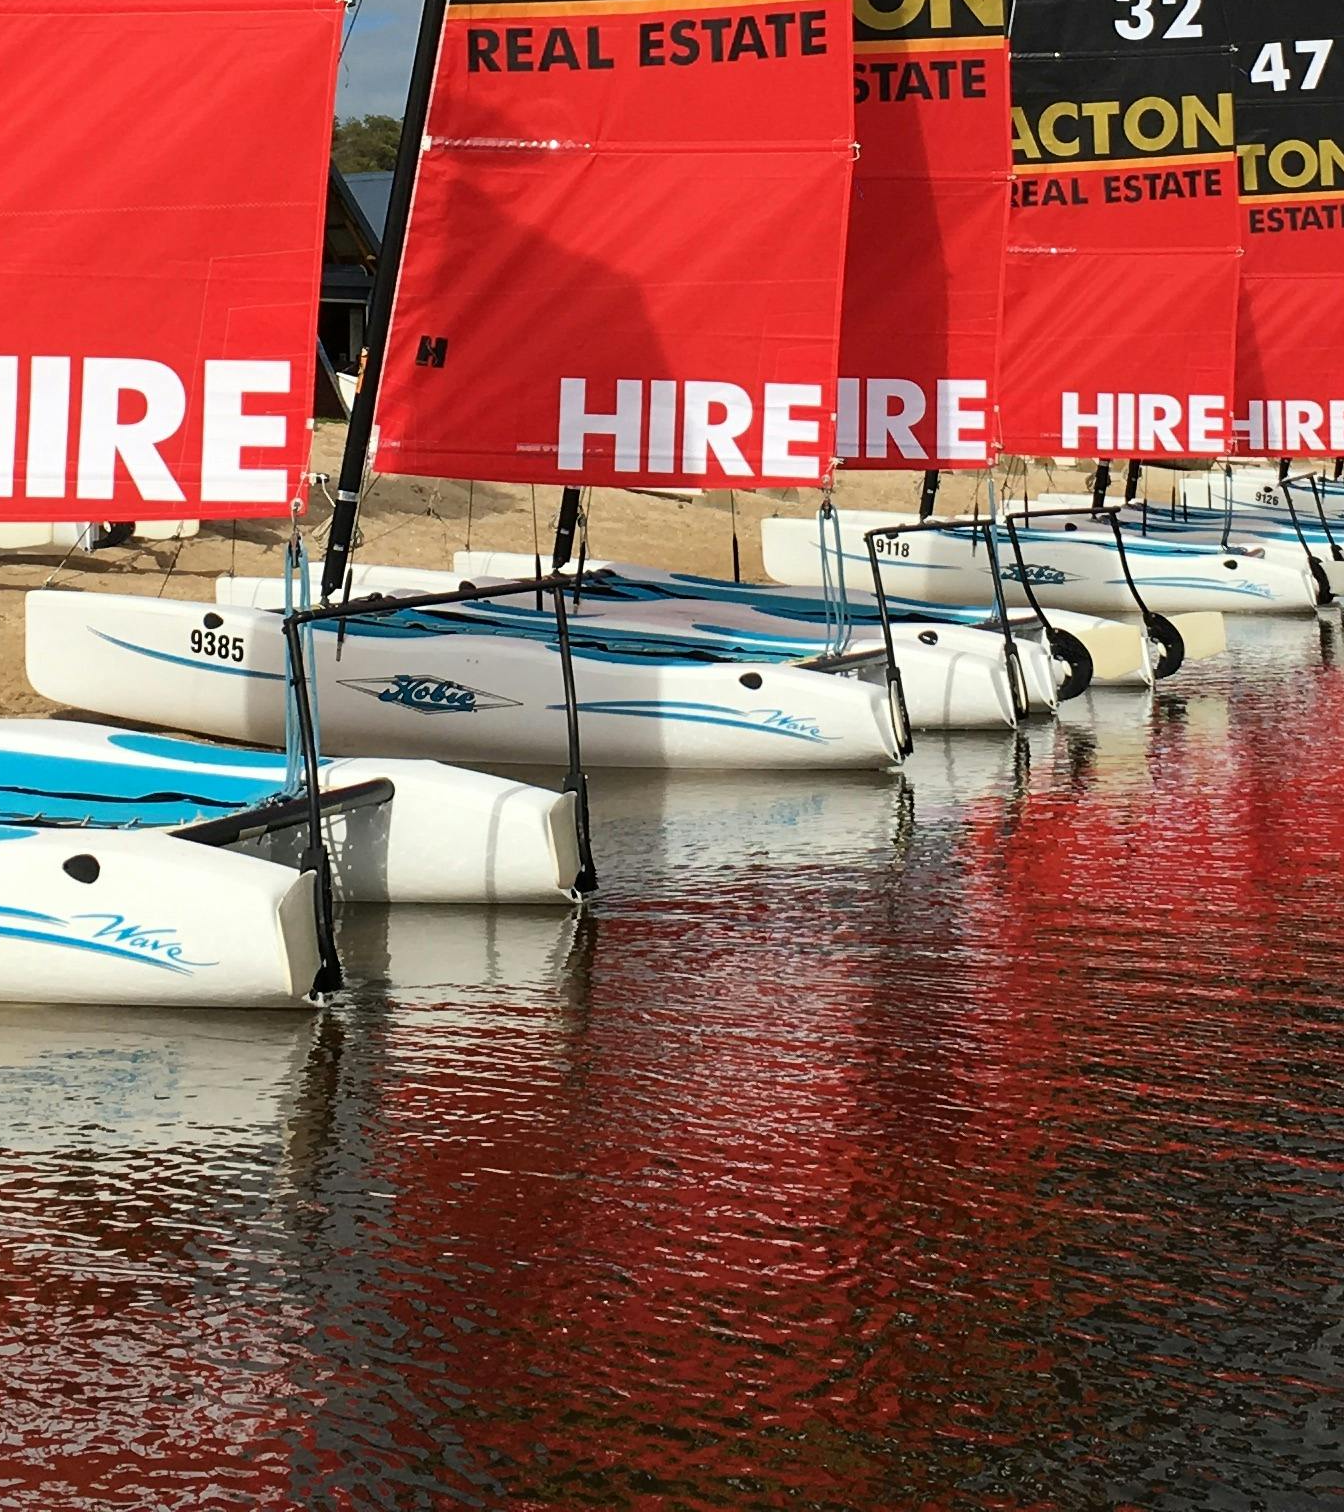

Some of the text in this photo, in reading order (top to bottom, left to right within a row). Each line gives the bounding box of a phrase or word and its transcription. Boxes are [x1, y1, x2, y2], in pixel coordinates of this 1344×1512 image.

[467, 10, 828, 72] REAL ESTATE
[1250, 39, 1333, 92] 47
[1011, 93, 1234, 159] ACTON
[1104, 168, 1222, 204] ESTATE
[557, 378, 822, 478] HIRE
[1062, 392, 1225, 452] HIRE
[876, 538, 910, 557] 9118
[191, 629, 244, 662] 9385
[378, 675, 476, 712] Hobie
[750, 709, 843, 739] Wave
[71, 913, 220, 966] Wave
